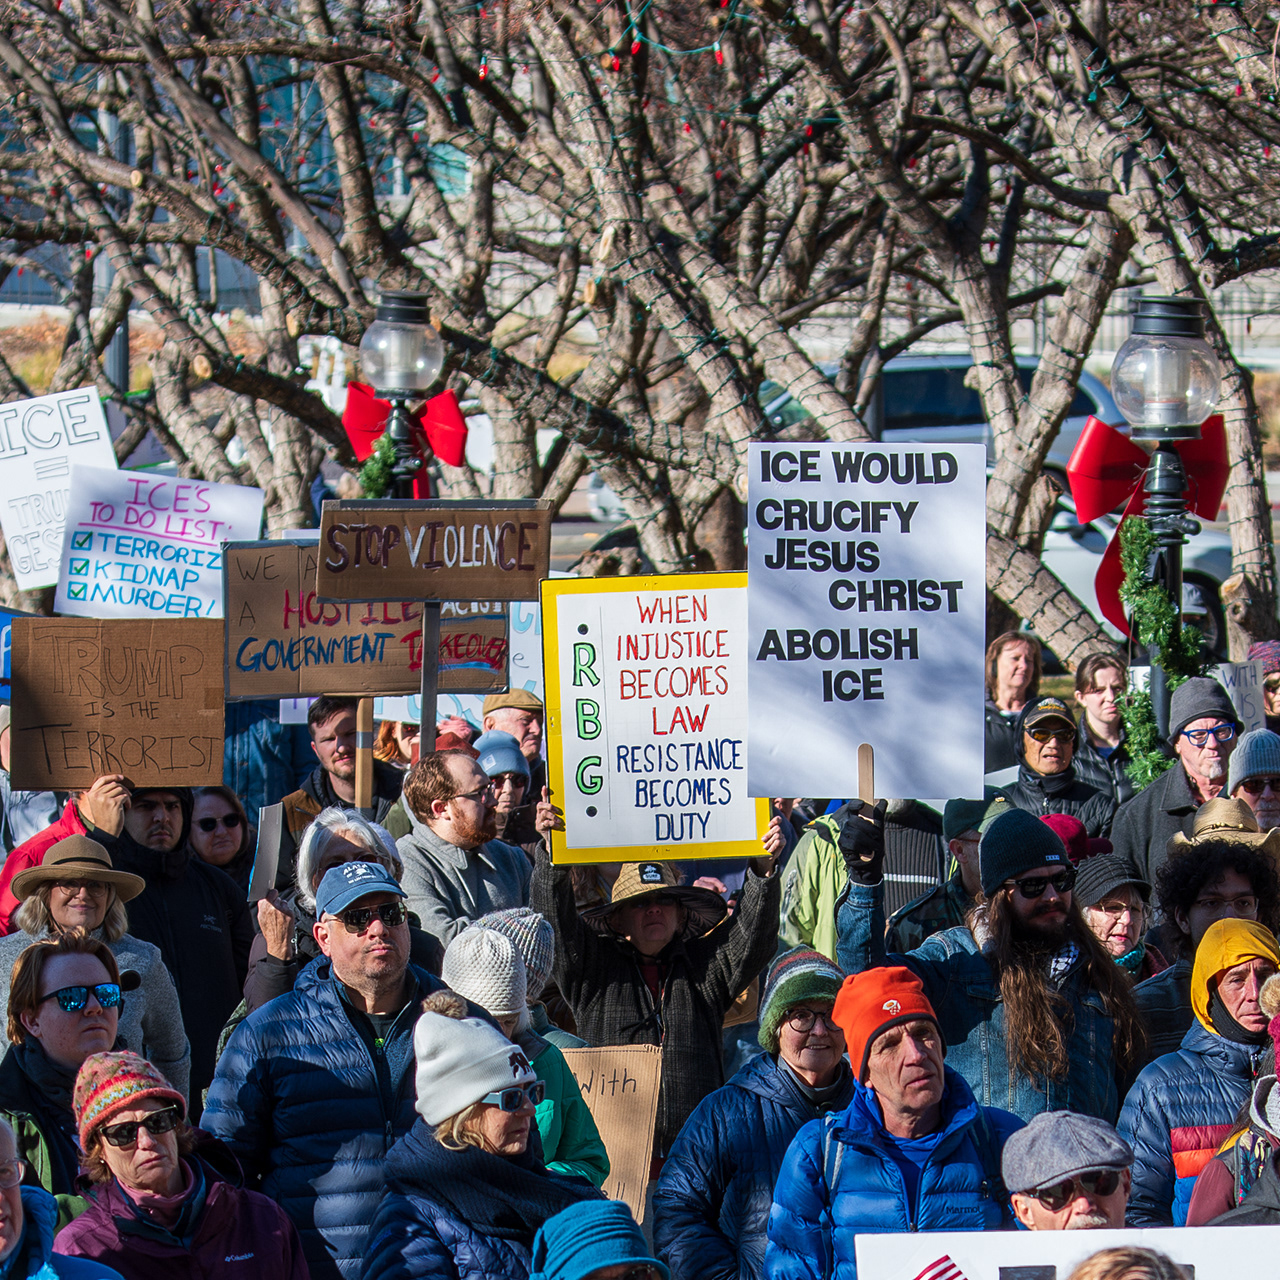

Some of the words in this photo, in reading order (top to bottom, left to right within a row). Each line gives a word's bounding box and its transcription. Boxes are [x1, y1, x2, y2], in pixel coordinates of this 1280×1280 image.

[761, 450, 821, 483] ICE
[832, 451, 959, 485] WOULD
[125, 478, 211, 513] ICE'S
[90, 501, 115, 522] TO
[124, 506, 156, 529] DO
[756, 498, 919, 533] CRUCIFY
[326, 522, 401, 573] STOP
[404, 521, 539, 571] VIOLENCE
[764, 538, 880, 573] JESUS
[94, 560, 199, 591] KIDNAP
[236, 554, 279, 581] WE
[90, 583, 215, 617] MURDER!
[636, 594, 708, 624] WHEN
[829, 579, 963, 613] CHRIST
[239, 601, 256, 627] A
[236, 632, 396, 672] GOVERNMENT
[401, 629, 509, 671] TKEOVER
[617, 629, 730, 661] INJUSTICE
[756, 628, 919, 661] ABOLISH
[33, 626, 204, 699] TRUMP
[1222, 664, 1257, 689] WITH
[620, 665, 729, 700] BECOMES
[822, 668, 885, 702] ICE
[85, 702, 115, 717] IS
[122, 701, 159, 719] THE
[652, 704, 710, 735] LAW
[20, 724, 221, 774] TERRORIST
[617, 738, 744, 773] RESISTANCE
[634, 777, 731, 808] BECOMES
[656, 810, 711, 841] DUTY
